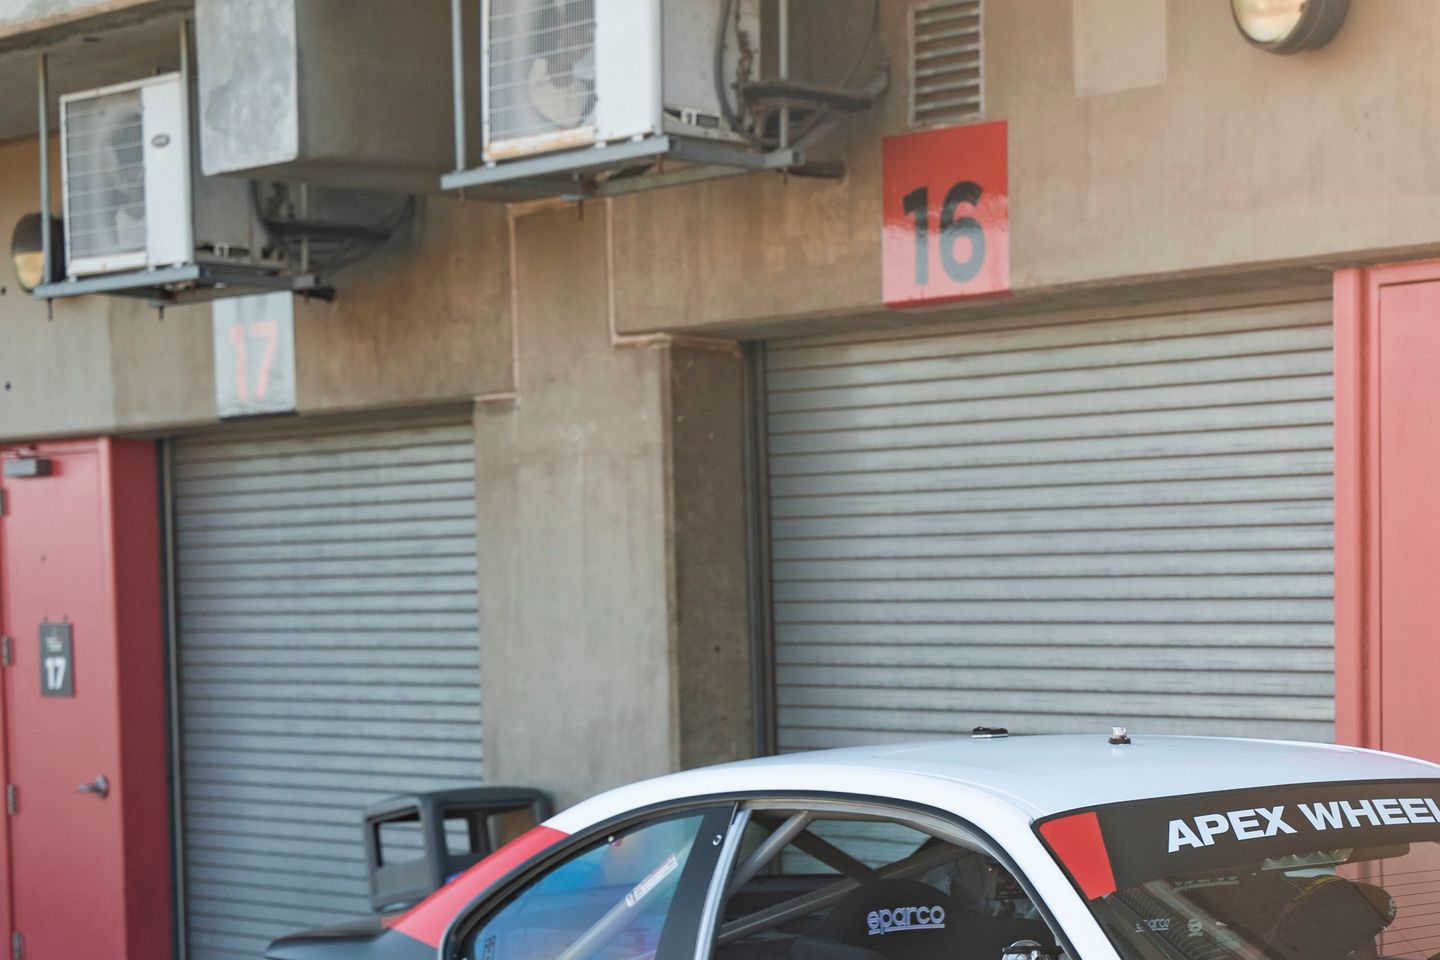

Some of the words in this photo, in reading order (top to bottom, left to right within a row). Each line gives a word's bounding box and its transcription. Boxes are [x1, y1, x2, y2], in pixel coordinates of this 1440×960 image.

[902, 180, 986, 286] 16
[227, 319, 279, 402] 17
[44, 656, 67, 690] 17
[1167, 805, 1298, 853] APEX
[866, 904, 946, 935] sparco
